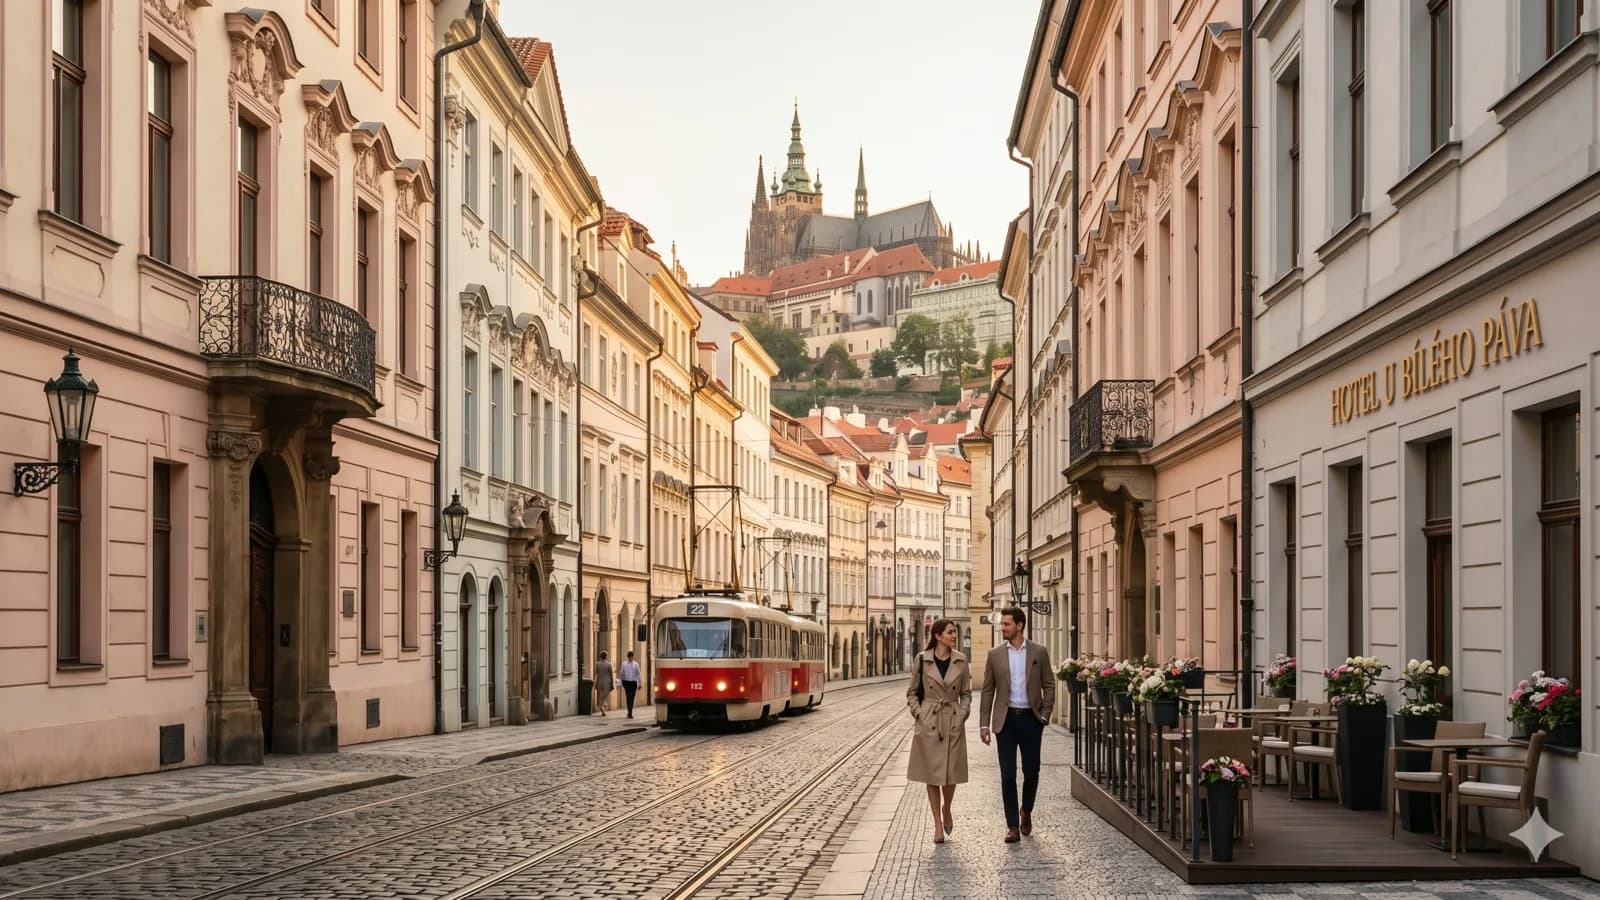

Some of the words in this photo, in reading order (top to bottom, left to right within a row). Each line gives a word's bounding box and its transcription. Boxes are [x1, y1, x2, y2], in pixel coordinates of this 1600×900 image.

[1330, 371, 1380, 426] HOTEL
[1384, 362, 1396, 405] U
[1401, 328, 1475, 398] BÍLÉHO
[1481, 297, 1543, 367] PÁVA
[691, 604, 705, 615] 22
